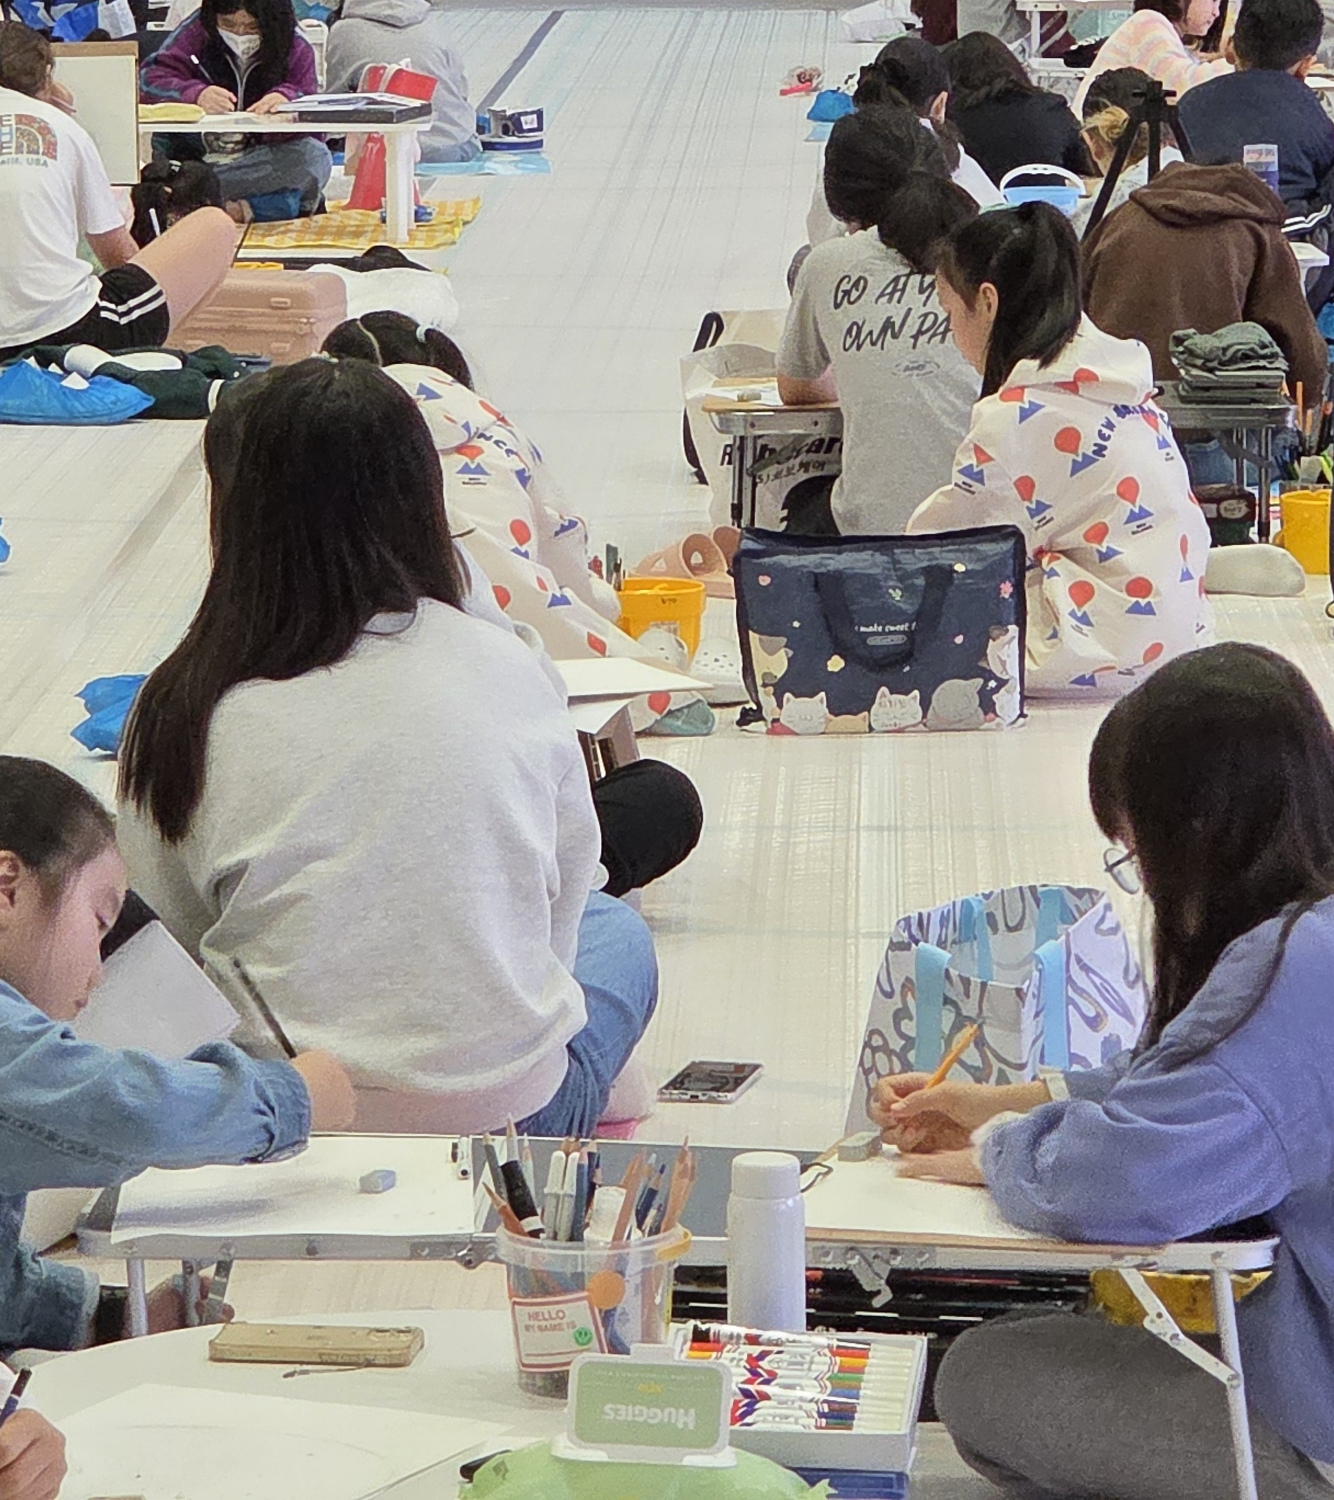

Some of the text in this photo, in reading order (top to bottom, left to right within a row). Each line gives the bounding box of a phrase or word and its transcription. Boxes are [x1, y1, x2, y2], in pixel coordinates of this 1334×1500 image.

[833, 274, 868, 310] GO
[909, 311, 952, 350] PA
[1092, 416, 1117, 458] NEW
[528, 1309, 567, 1321] HELLO
